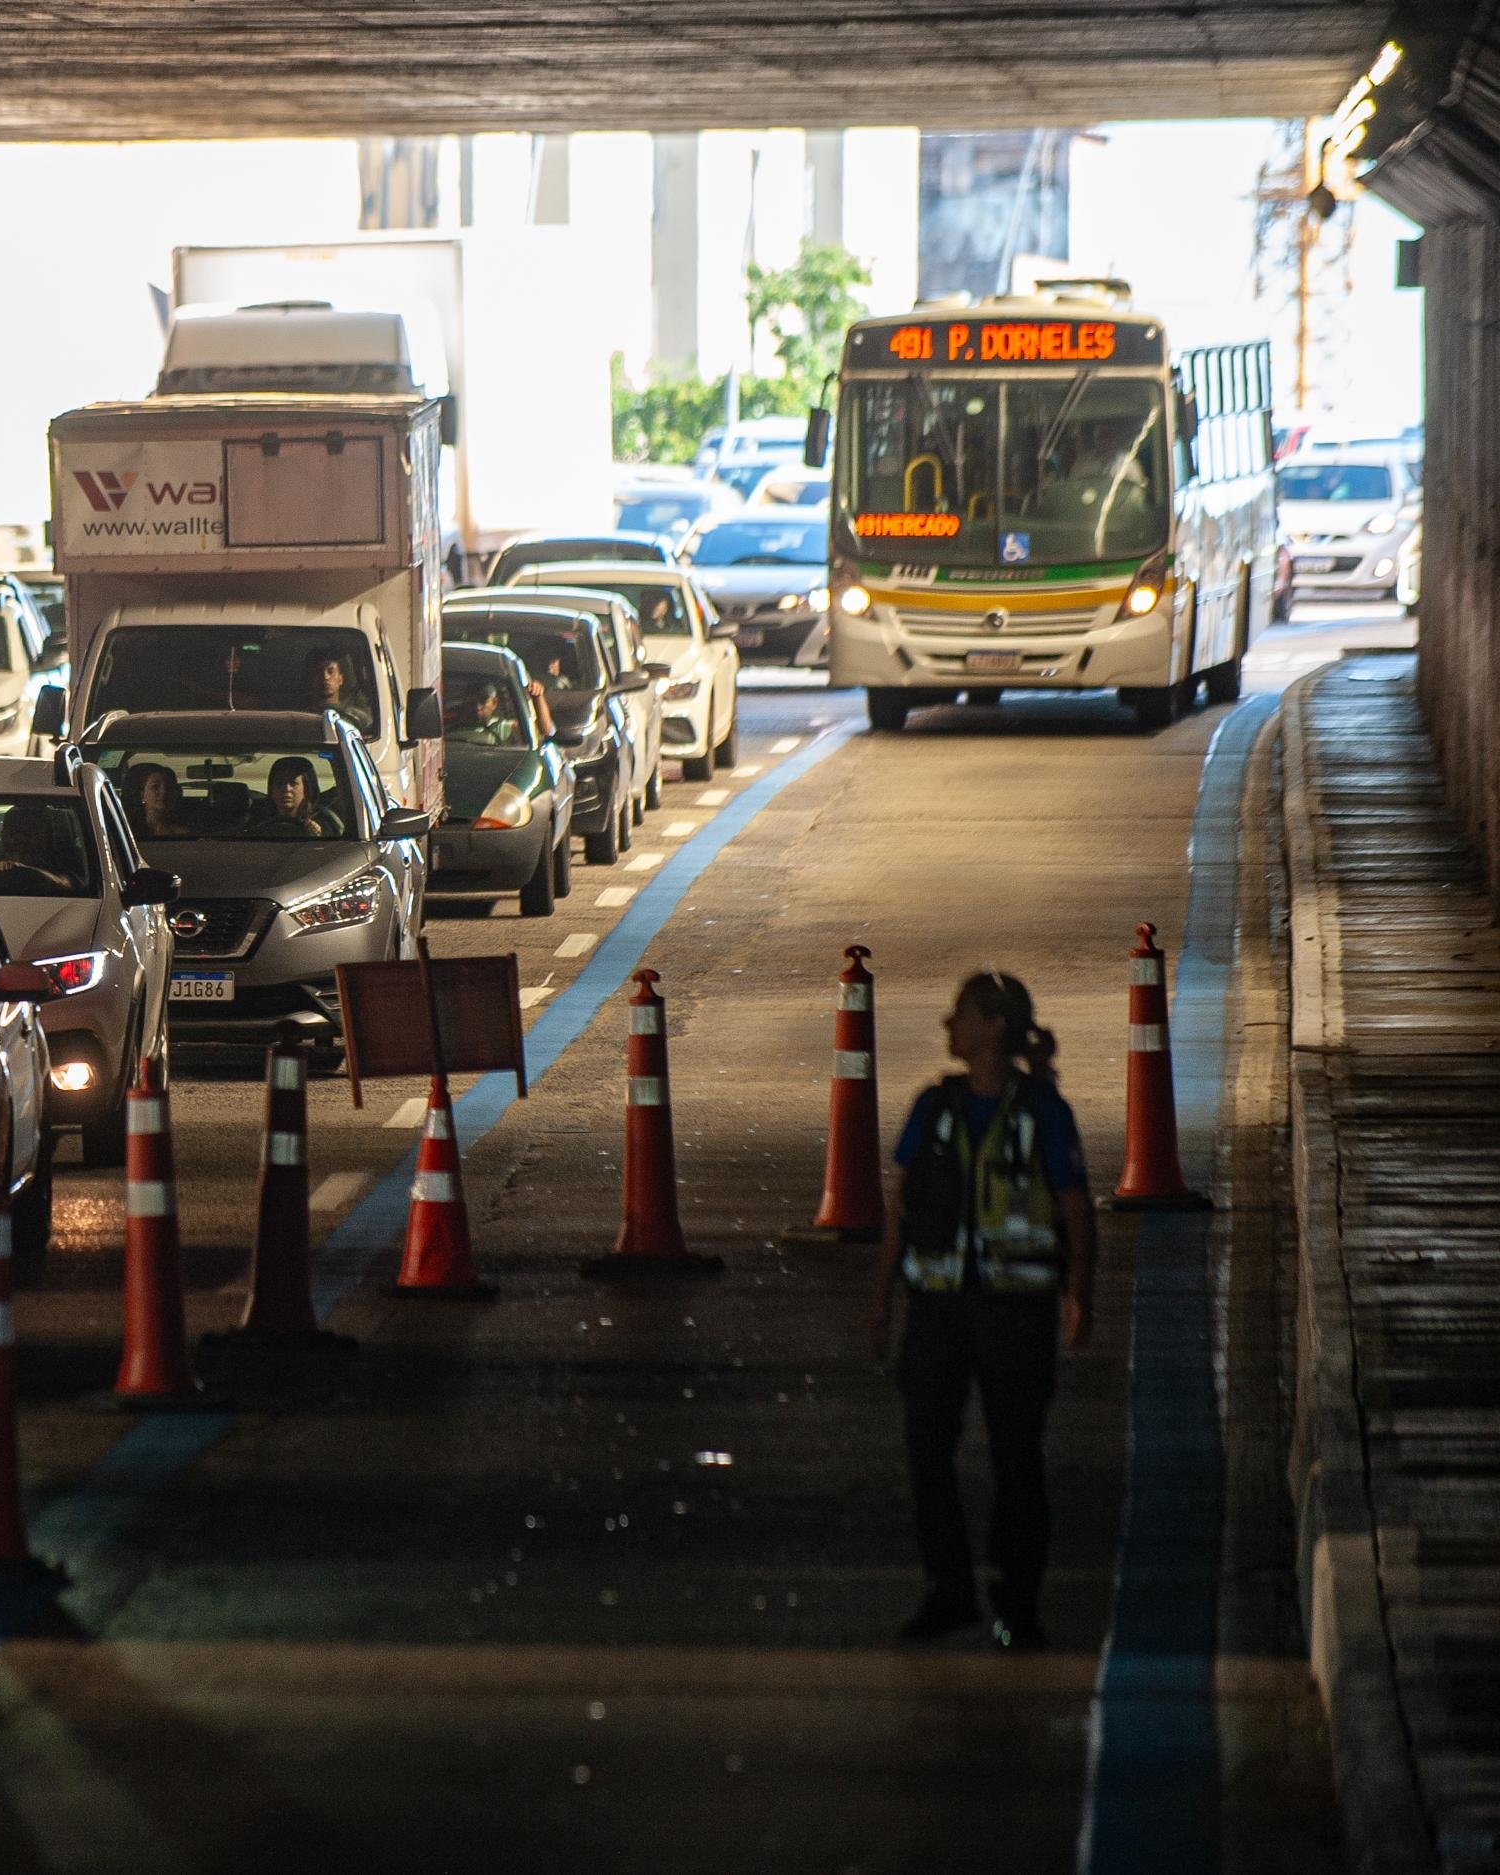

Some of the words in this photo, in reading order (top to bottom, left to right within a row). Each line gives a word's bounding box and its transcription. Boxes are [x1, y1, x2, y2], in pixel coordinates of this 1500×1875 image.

[889, 326, 933, 359] 491
[980, 323, 1116, 360] DORNELES
[82, 517, 225, 537] www.wallte
[173, 981, 224, 998] J1G86
